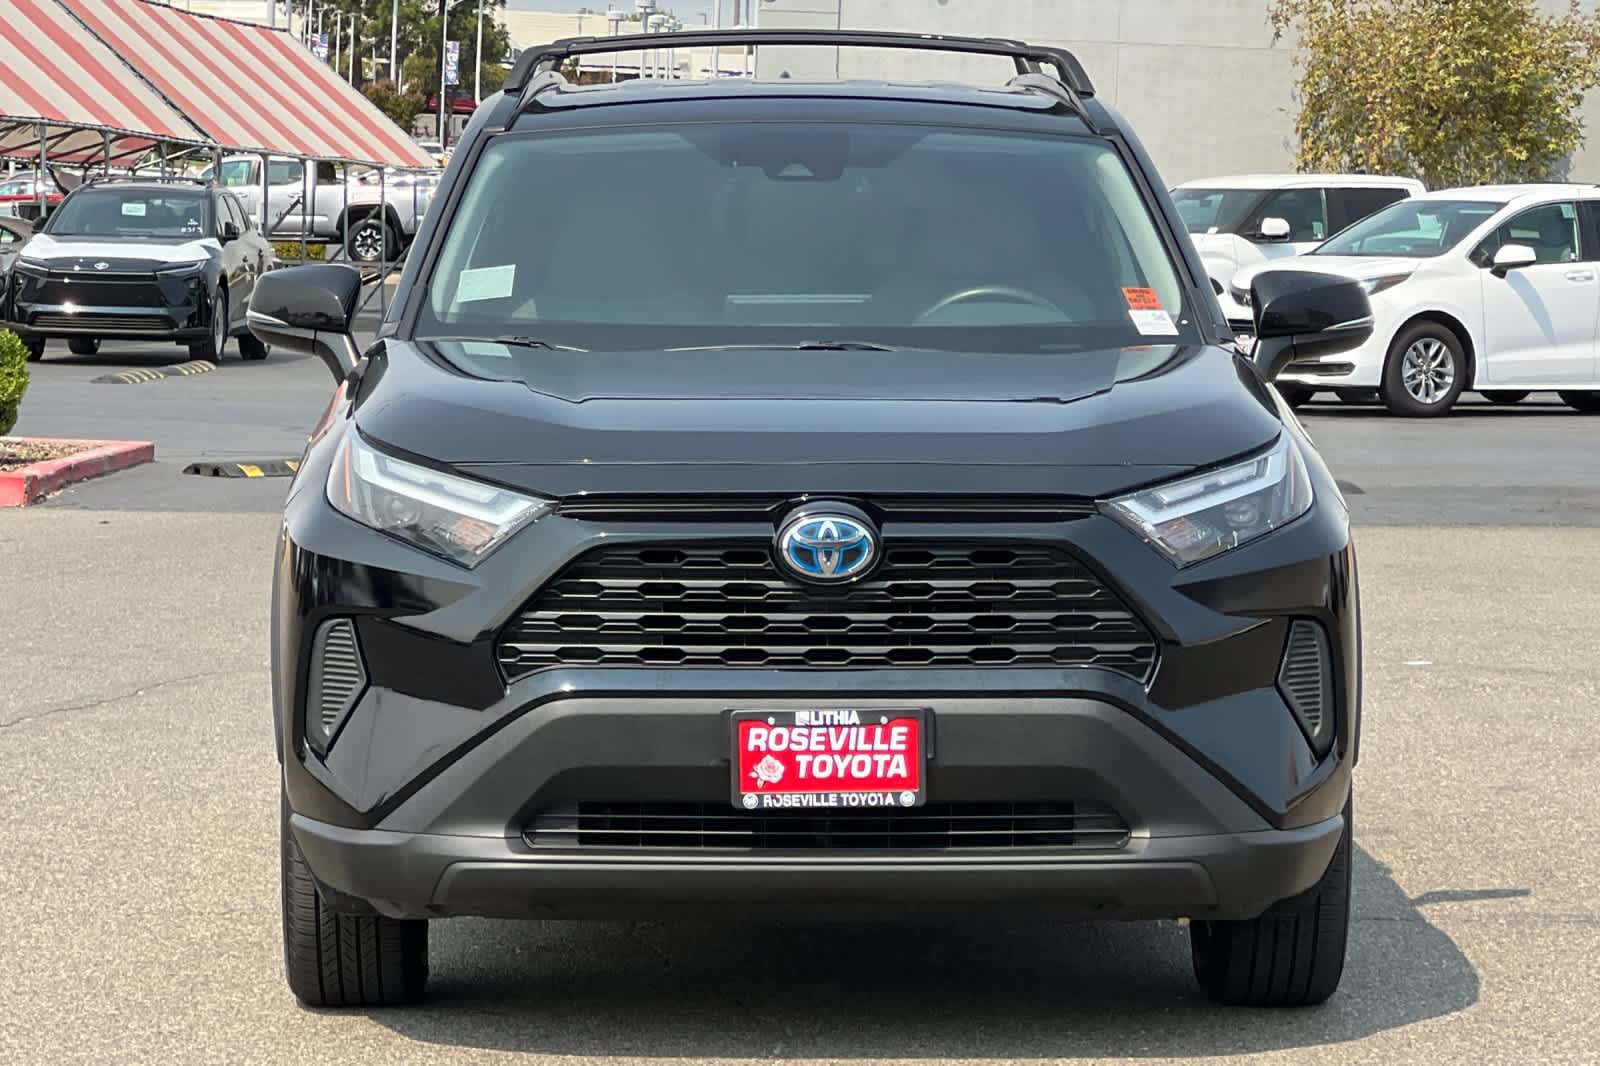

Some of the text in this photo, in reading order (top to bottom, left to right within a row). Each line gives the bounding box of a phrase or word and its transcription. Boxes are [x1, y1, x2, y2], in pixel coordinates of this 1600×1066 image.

[810, 710, 860, 725] LITHIA
[747, 726, 908, 752] ROSEVILLE
[795, 754, 908, 779] TOYOTA
[763, 793, 895, 808] ROSEVILLE TOYOTA
